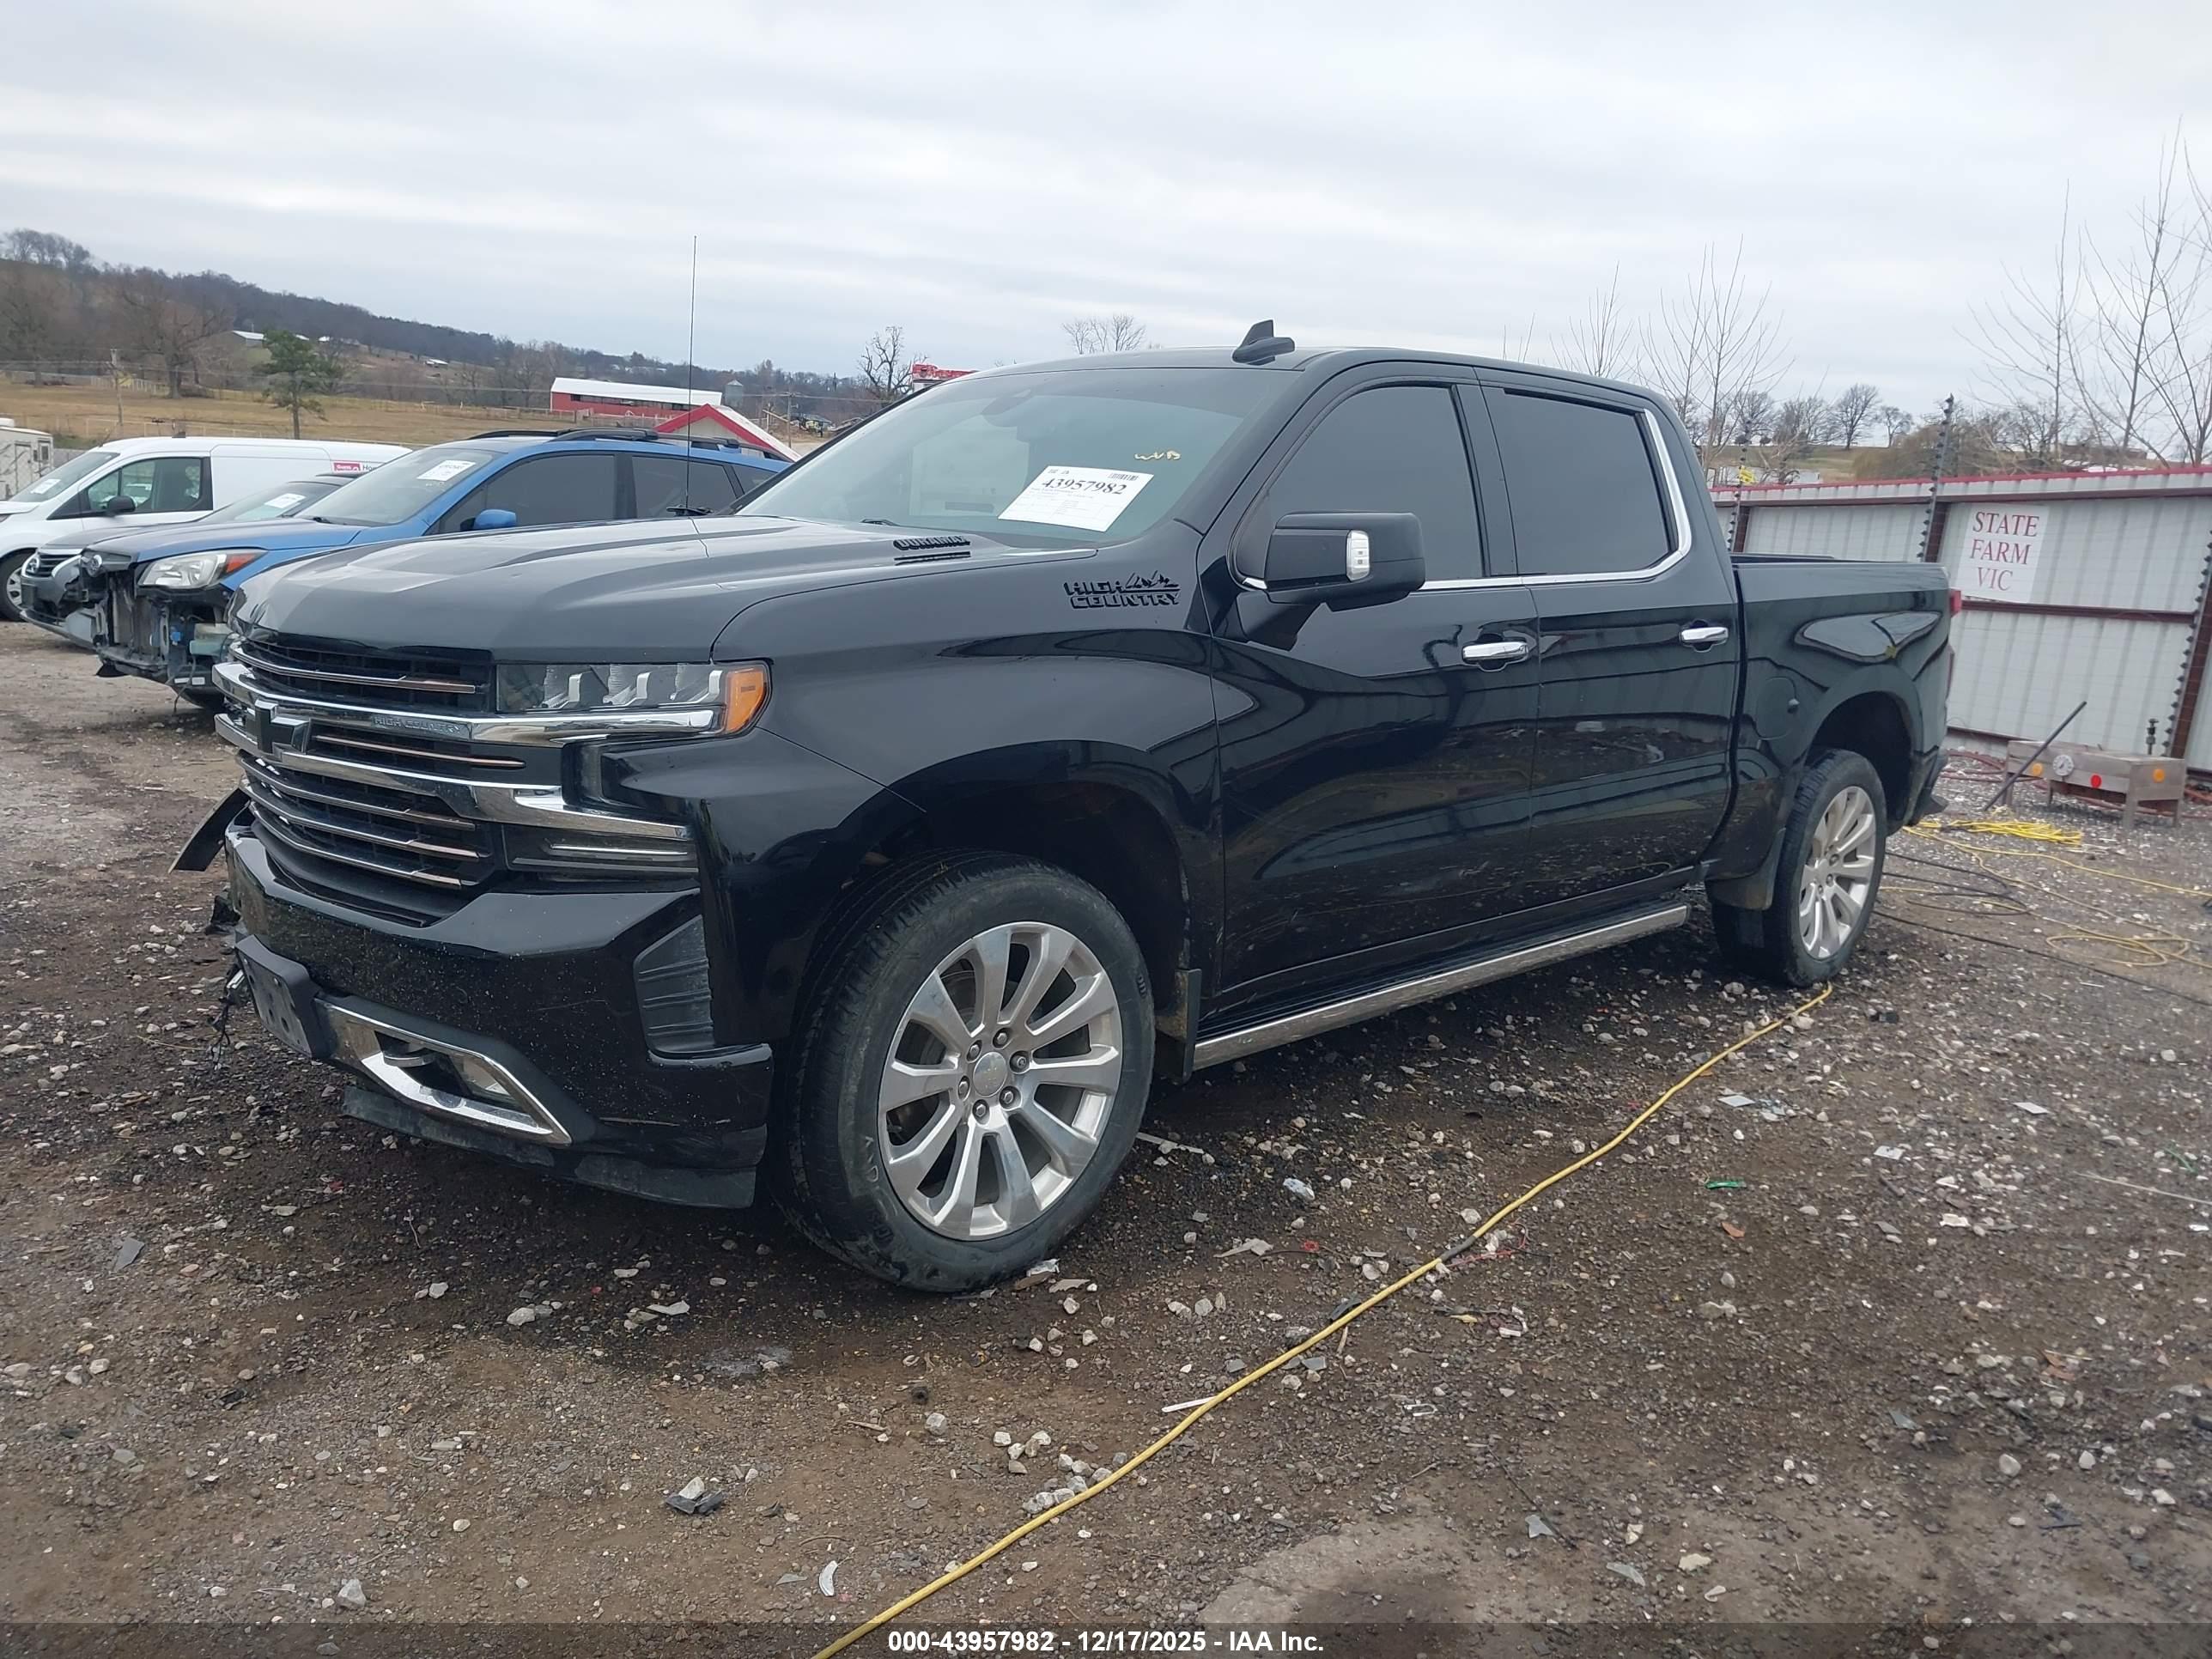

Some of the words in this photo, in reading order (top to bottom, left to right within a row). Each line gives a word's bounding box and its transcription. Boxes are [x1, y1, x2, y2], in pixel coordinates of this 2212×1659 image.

[1041, 477, 1128, 495] 43957982
[1972, 511, 2040, 538] STATE
[1969, 538, 2032, 565] FARM
[1063, 580, 1126, 595] HIGH
[1977, 567, 2014, 591] VIC
[1070, 593, 1180, 609] COUNTRY
[374, 716, 402, 727] HIGH
